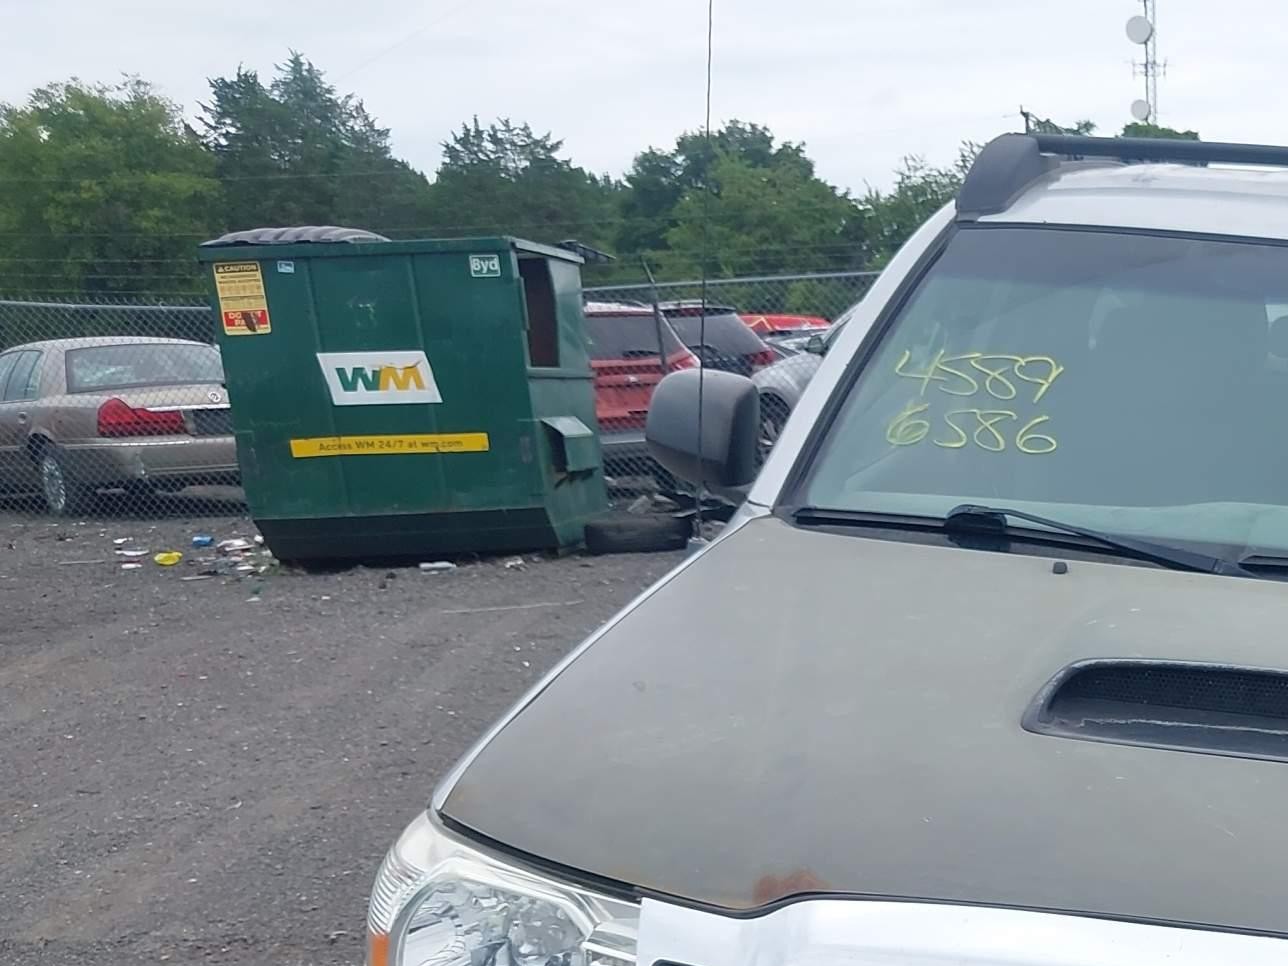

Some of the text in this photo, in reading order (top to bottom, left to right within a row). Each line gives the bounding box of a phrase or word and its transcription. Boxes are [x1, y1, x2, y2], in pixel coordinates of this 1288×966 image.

[224, 264, 257, 272] CAUTION
[472, 257, 498, 274] Byd
[335, 365, 426, 392] WM
[895, 349, 1064, 404] 4589
[886, 402, 1057, 454] 6586
[319, 439, 464, 451] Access WM 24/7 at wm.com
